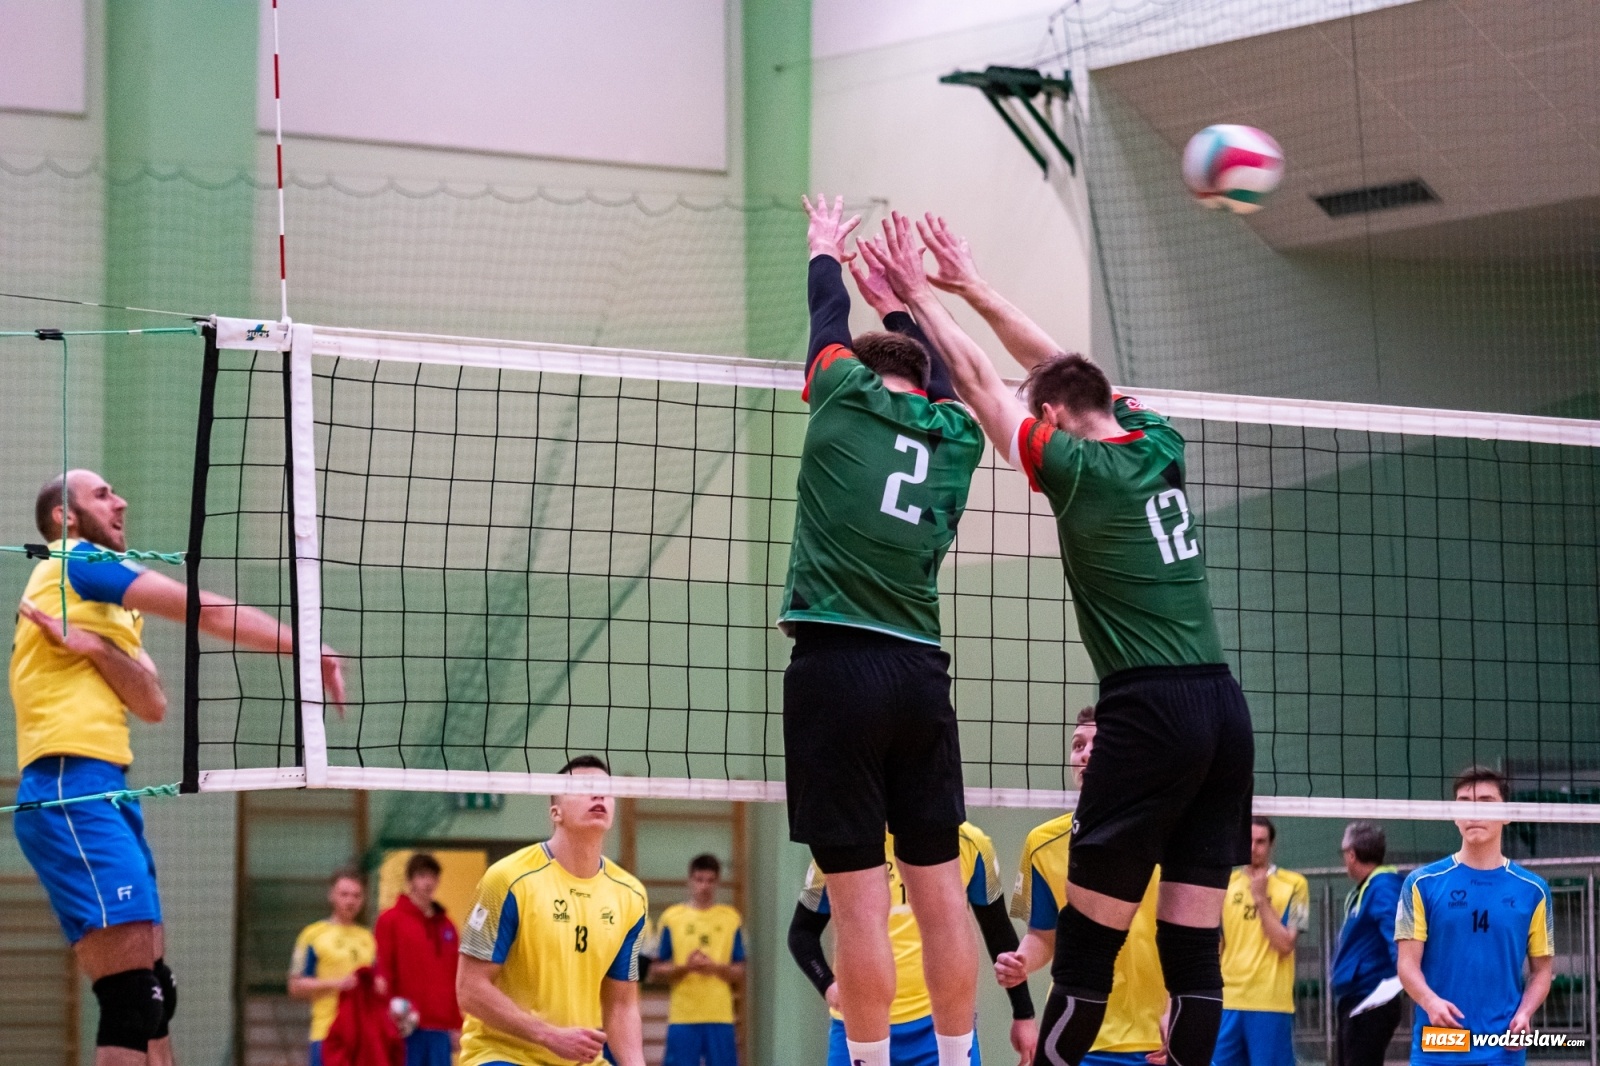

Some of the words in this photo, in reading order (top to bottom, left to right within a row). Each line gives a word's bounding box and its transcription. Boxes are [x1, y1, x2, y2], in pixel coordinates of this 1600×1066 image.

[880, 434, 929, 525] 2
[1145, 488, 1199, 565] 12
[574, 925, 588, 953] 13
[1472, 909, 1489, 933] 14
